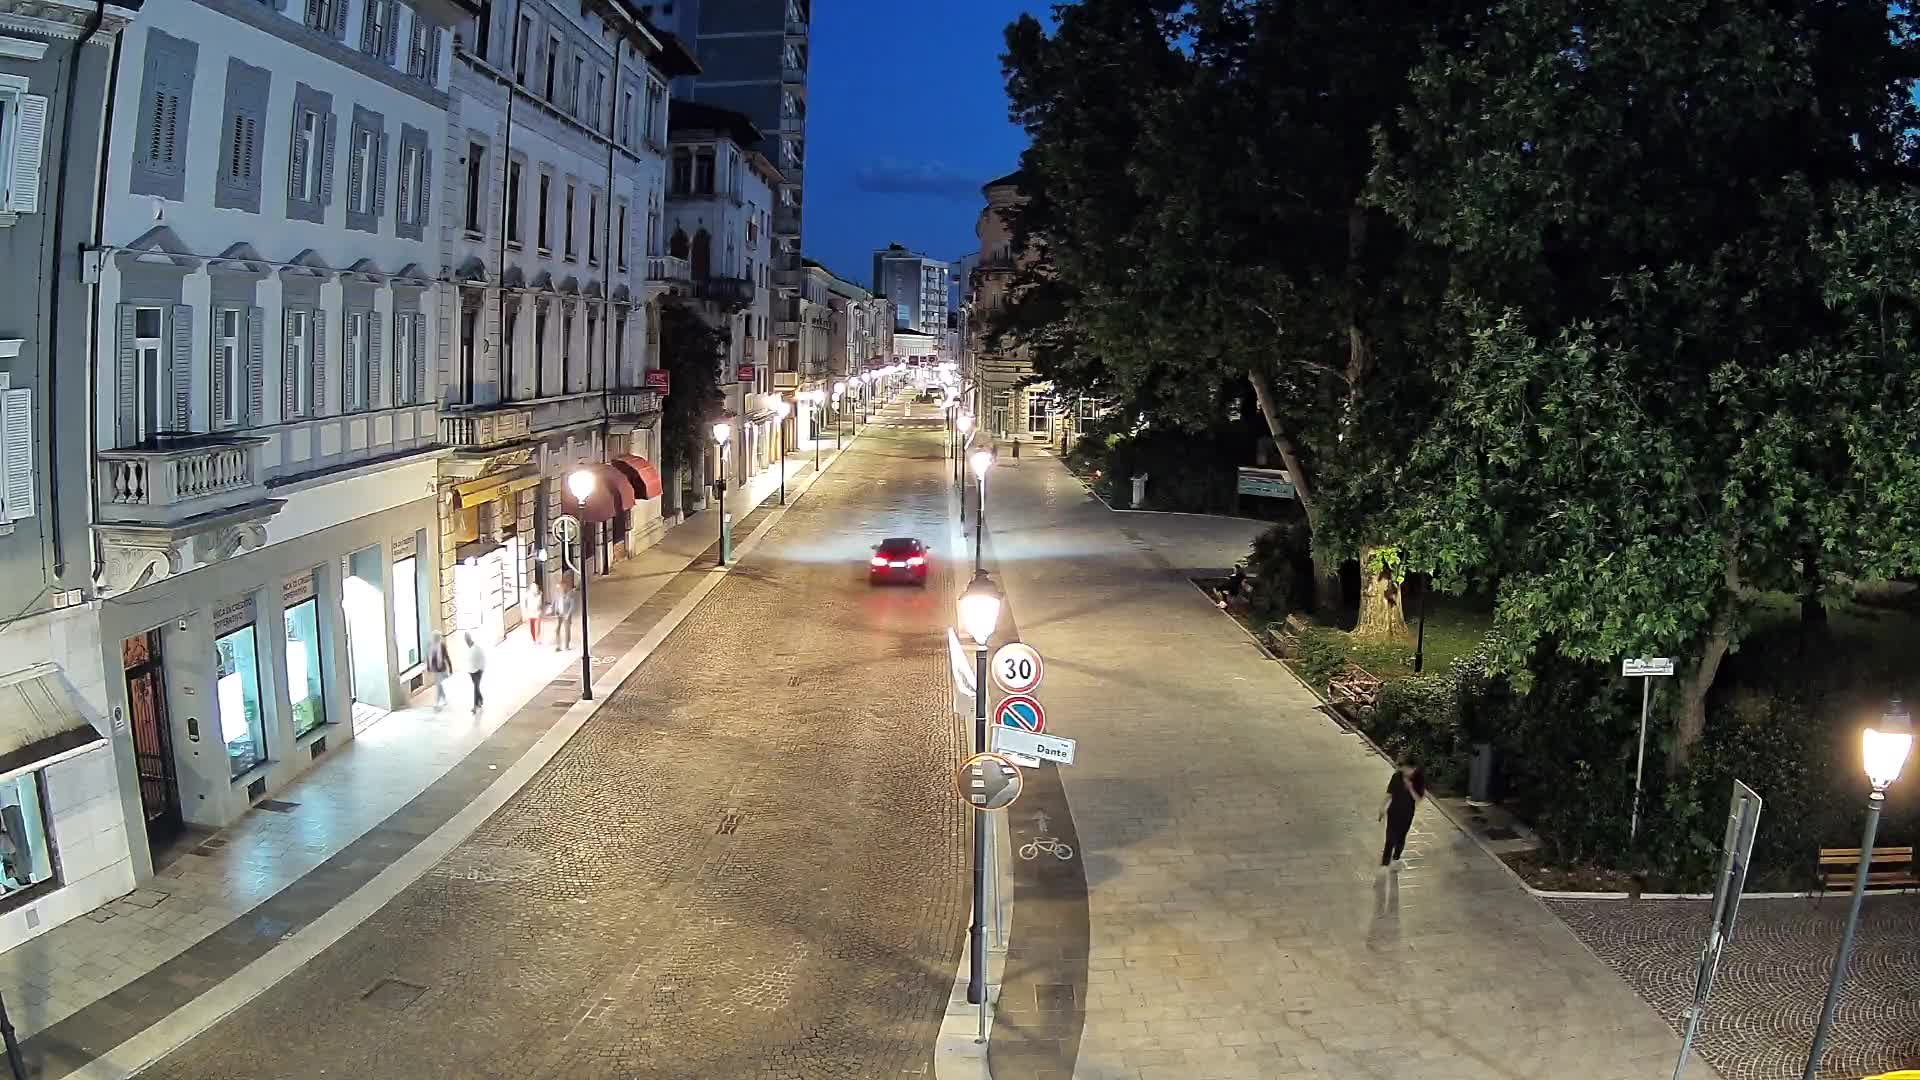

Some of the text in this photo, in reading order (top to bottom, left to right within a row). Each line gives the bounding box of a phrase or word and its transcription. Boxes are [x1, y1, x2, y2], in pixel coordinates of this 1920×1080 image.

[231, 597, 252, 612] CREDITO
[1005, 658, 1031, 679] 30
[1037, 744, 1067, 758] Dante
